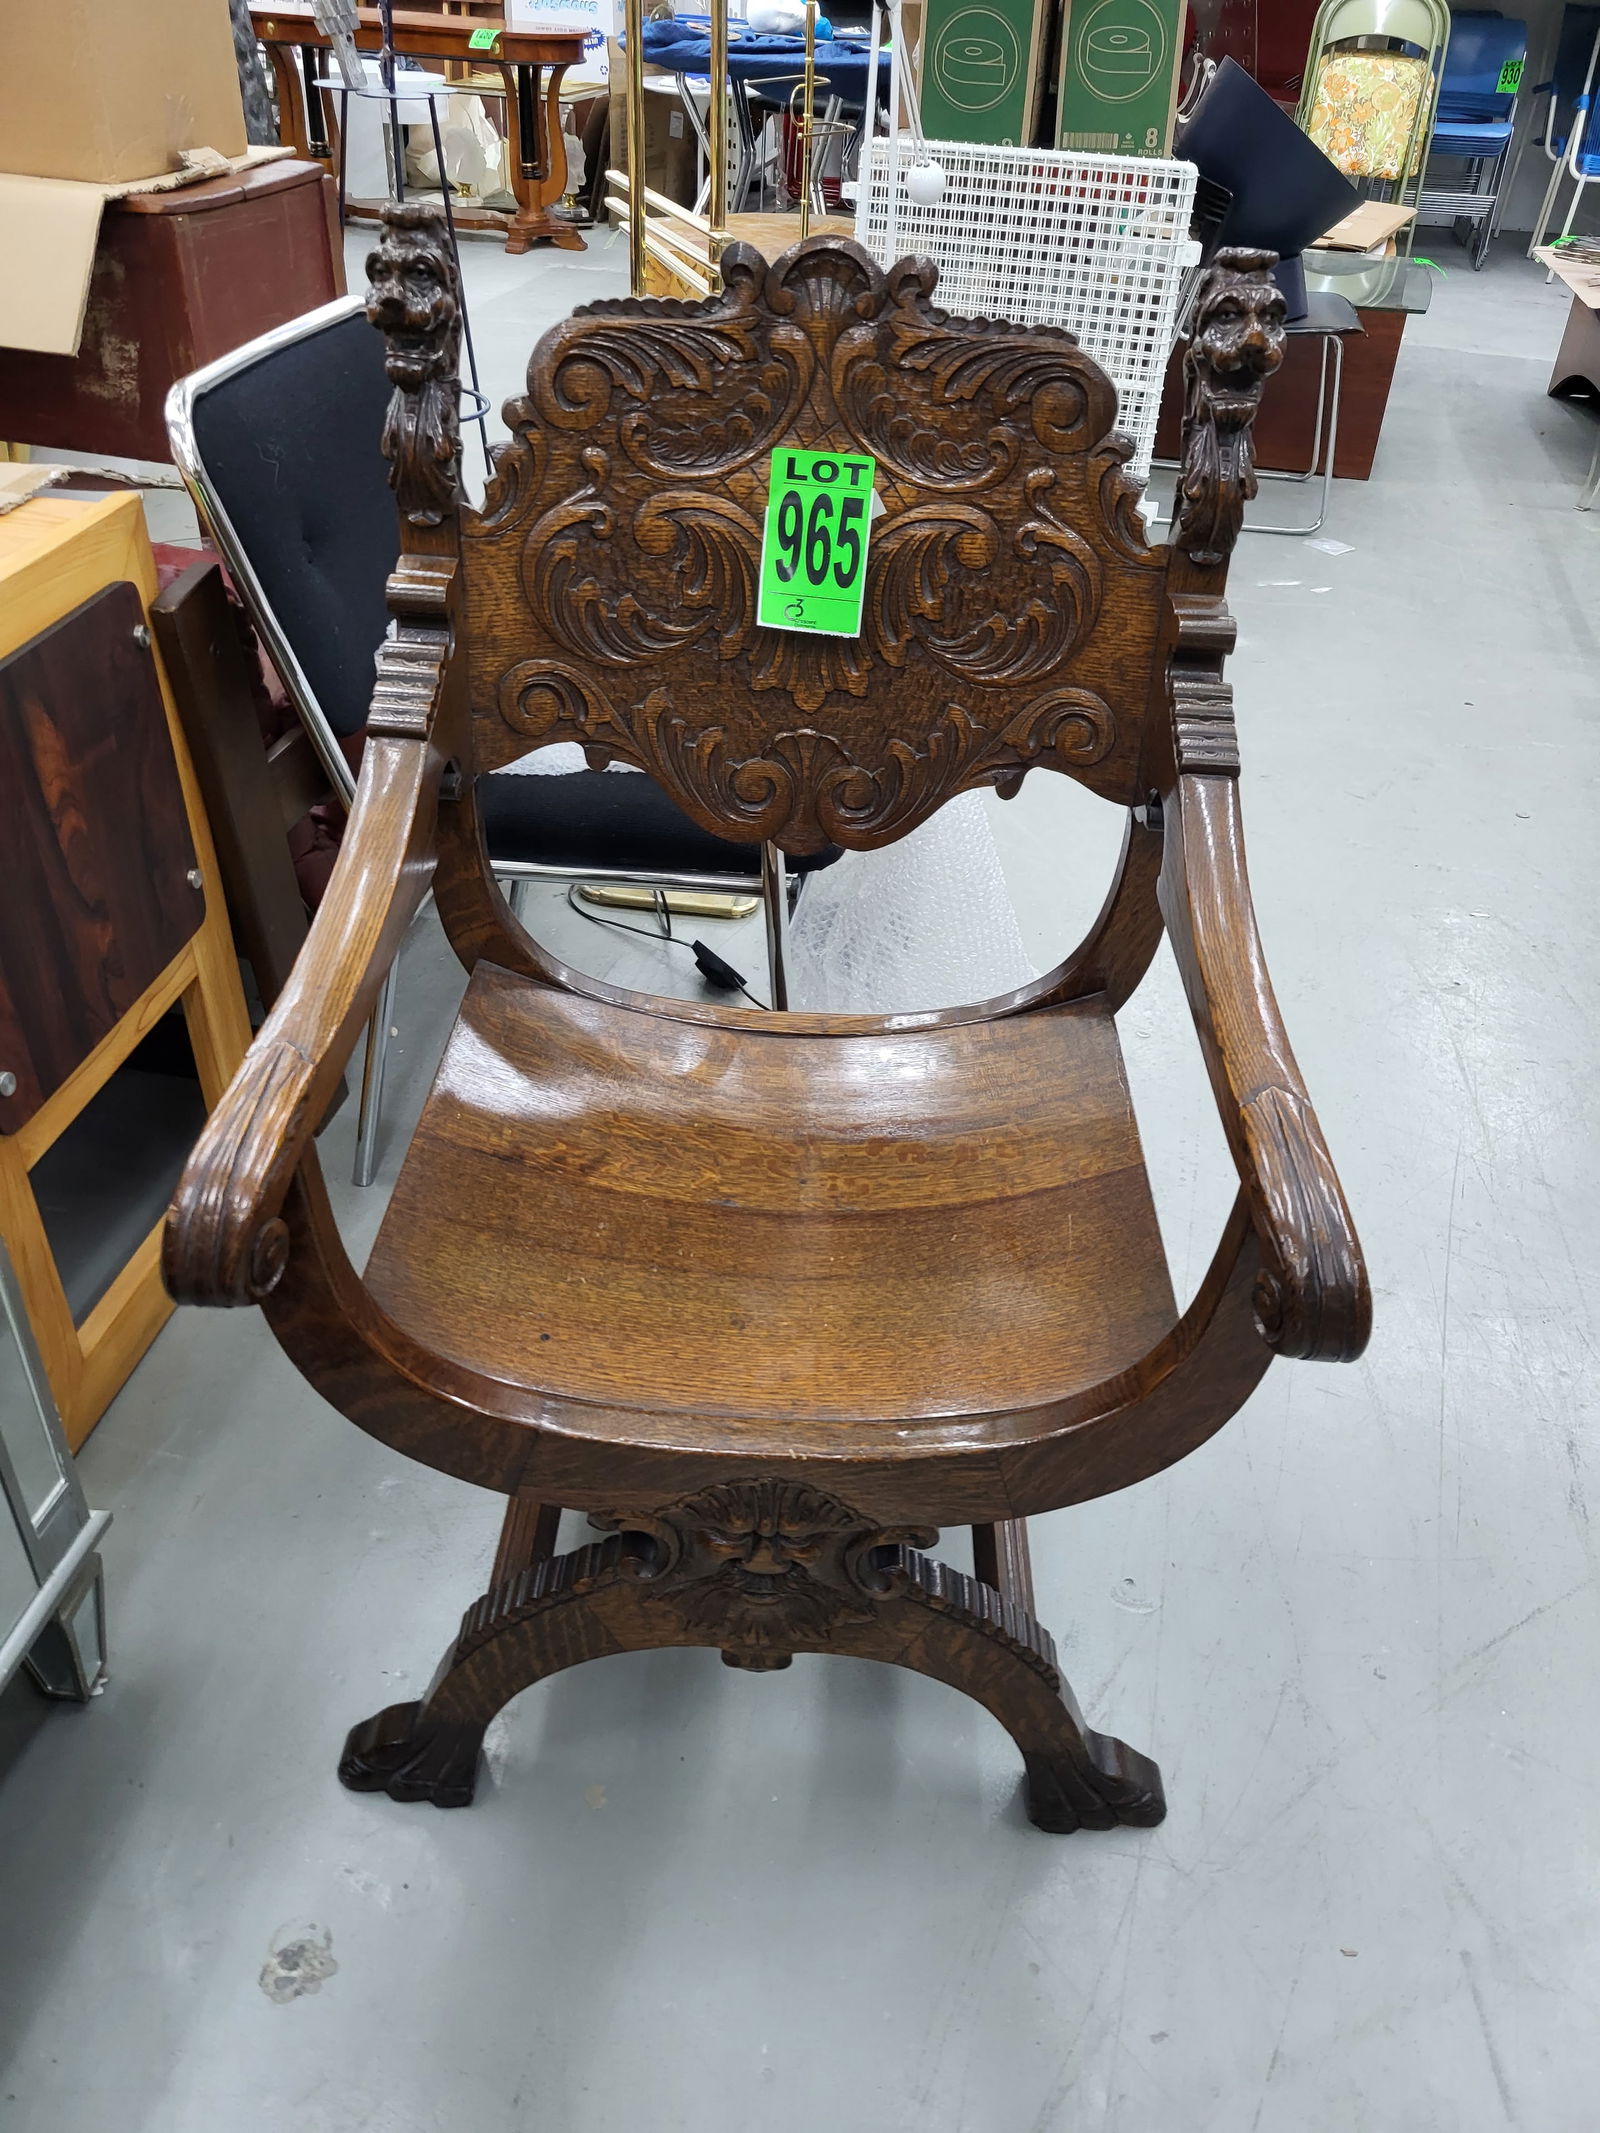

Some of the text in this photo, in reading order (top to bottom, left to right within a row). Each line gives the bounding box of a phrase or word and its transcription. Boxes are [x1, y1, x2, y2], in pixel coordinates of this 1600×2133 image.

[1501, 67, 1520, 84] 930
[1144, 127, 1158, 148] 8
[1137, 148, 1163, 156] ROLLS
[786, 456, 869, 486] LOT
[775, 490, 865, 589] 965
